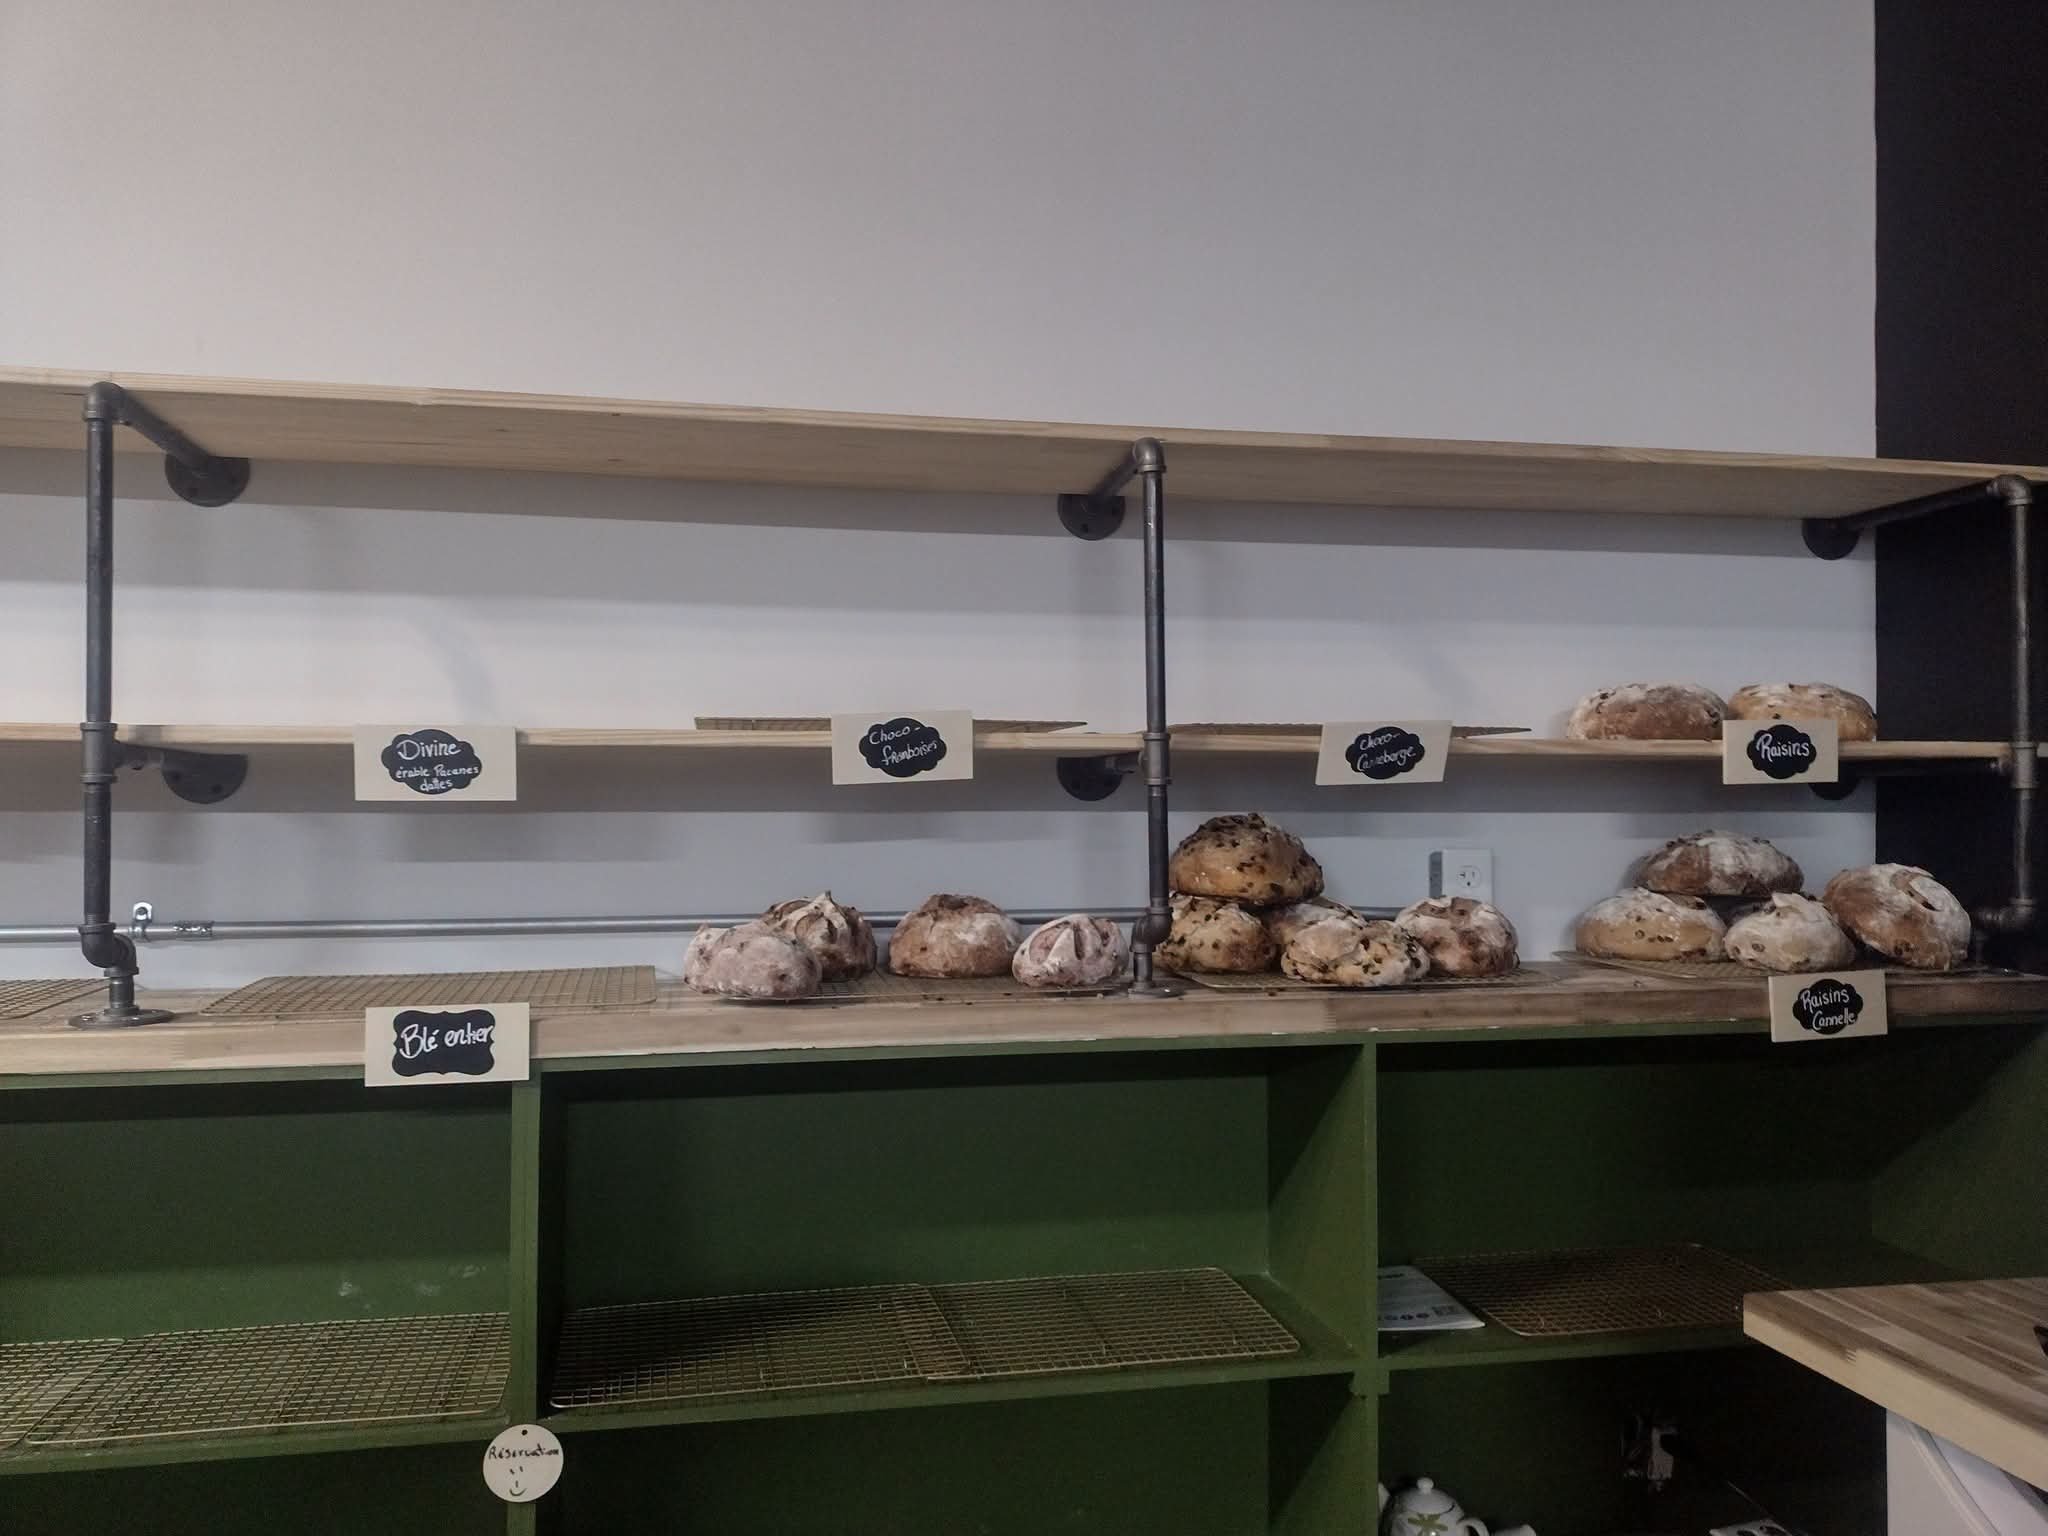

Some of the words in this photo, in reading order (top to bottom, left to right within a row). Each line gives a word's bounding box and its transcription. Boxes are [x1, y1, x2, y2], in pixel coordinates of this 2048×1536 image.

[396, 739, 462, 760] Divine
[1755, 733, 1810, 763] Raisins
[1800, 987, 1850, 1014] Raisins
[1812, 1007, 1856, 1031] Cannelle
[399, 1023, 439, 1059] Blé
[444, 1022, 494, 1047] entier
